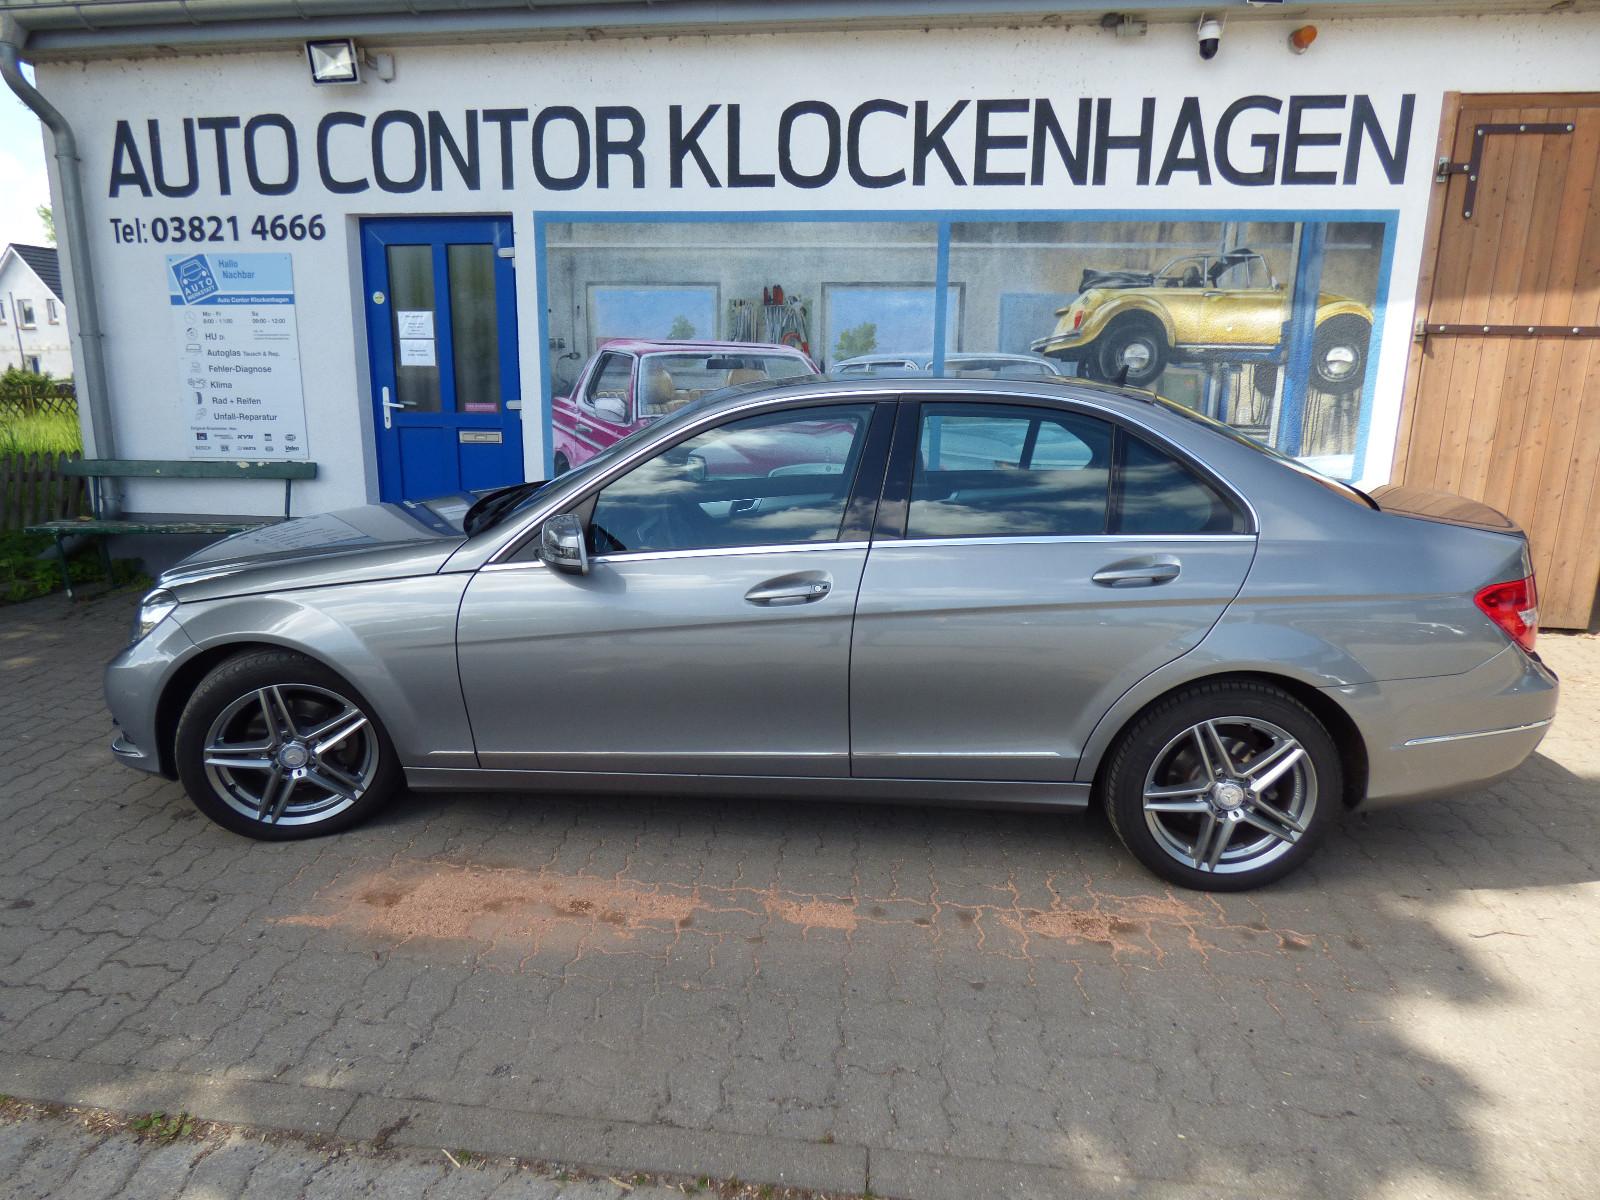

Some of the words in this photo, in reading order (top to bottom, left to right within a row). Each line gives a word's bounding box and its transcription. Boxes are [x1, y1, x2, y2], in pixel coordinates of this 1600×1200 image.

[108, 113, 300, 199] AUTO
[316, 105, 646, 196] CONTOR
[668, 93, 1416, 189] KLOCKENHAGEN
[109, 217, 148, 244] Tel:
[151, 215, 240, 243] 03821
[251, 213, 327, 241] 4666
[218, 259, 238, 268] Hallo
[222, 270, 255, 279] Nachbar
[184, 277, 214, 297] AUTO
[205, 332, 217, 341] HU
[207, 349, 241, 358] Autoglas
[208, 365, 272, 374] Fehler-Diagnose
[210, 381, 233, 389] Klima
[212, 397, 228, 405] Rad
[236, 397, 262, 405] Reifen
[213, 412, 278, 422] Unfall-Reparatur
